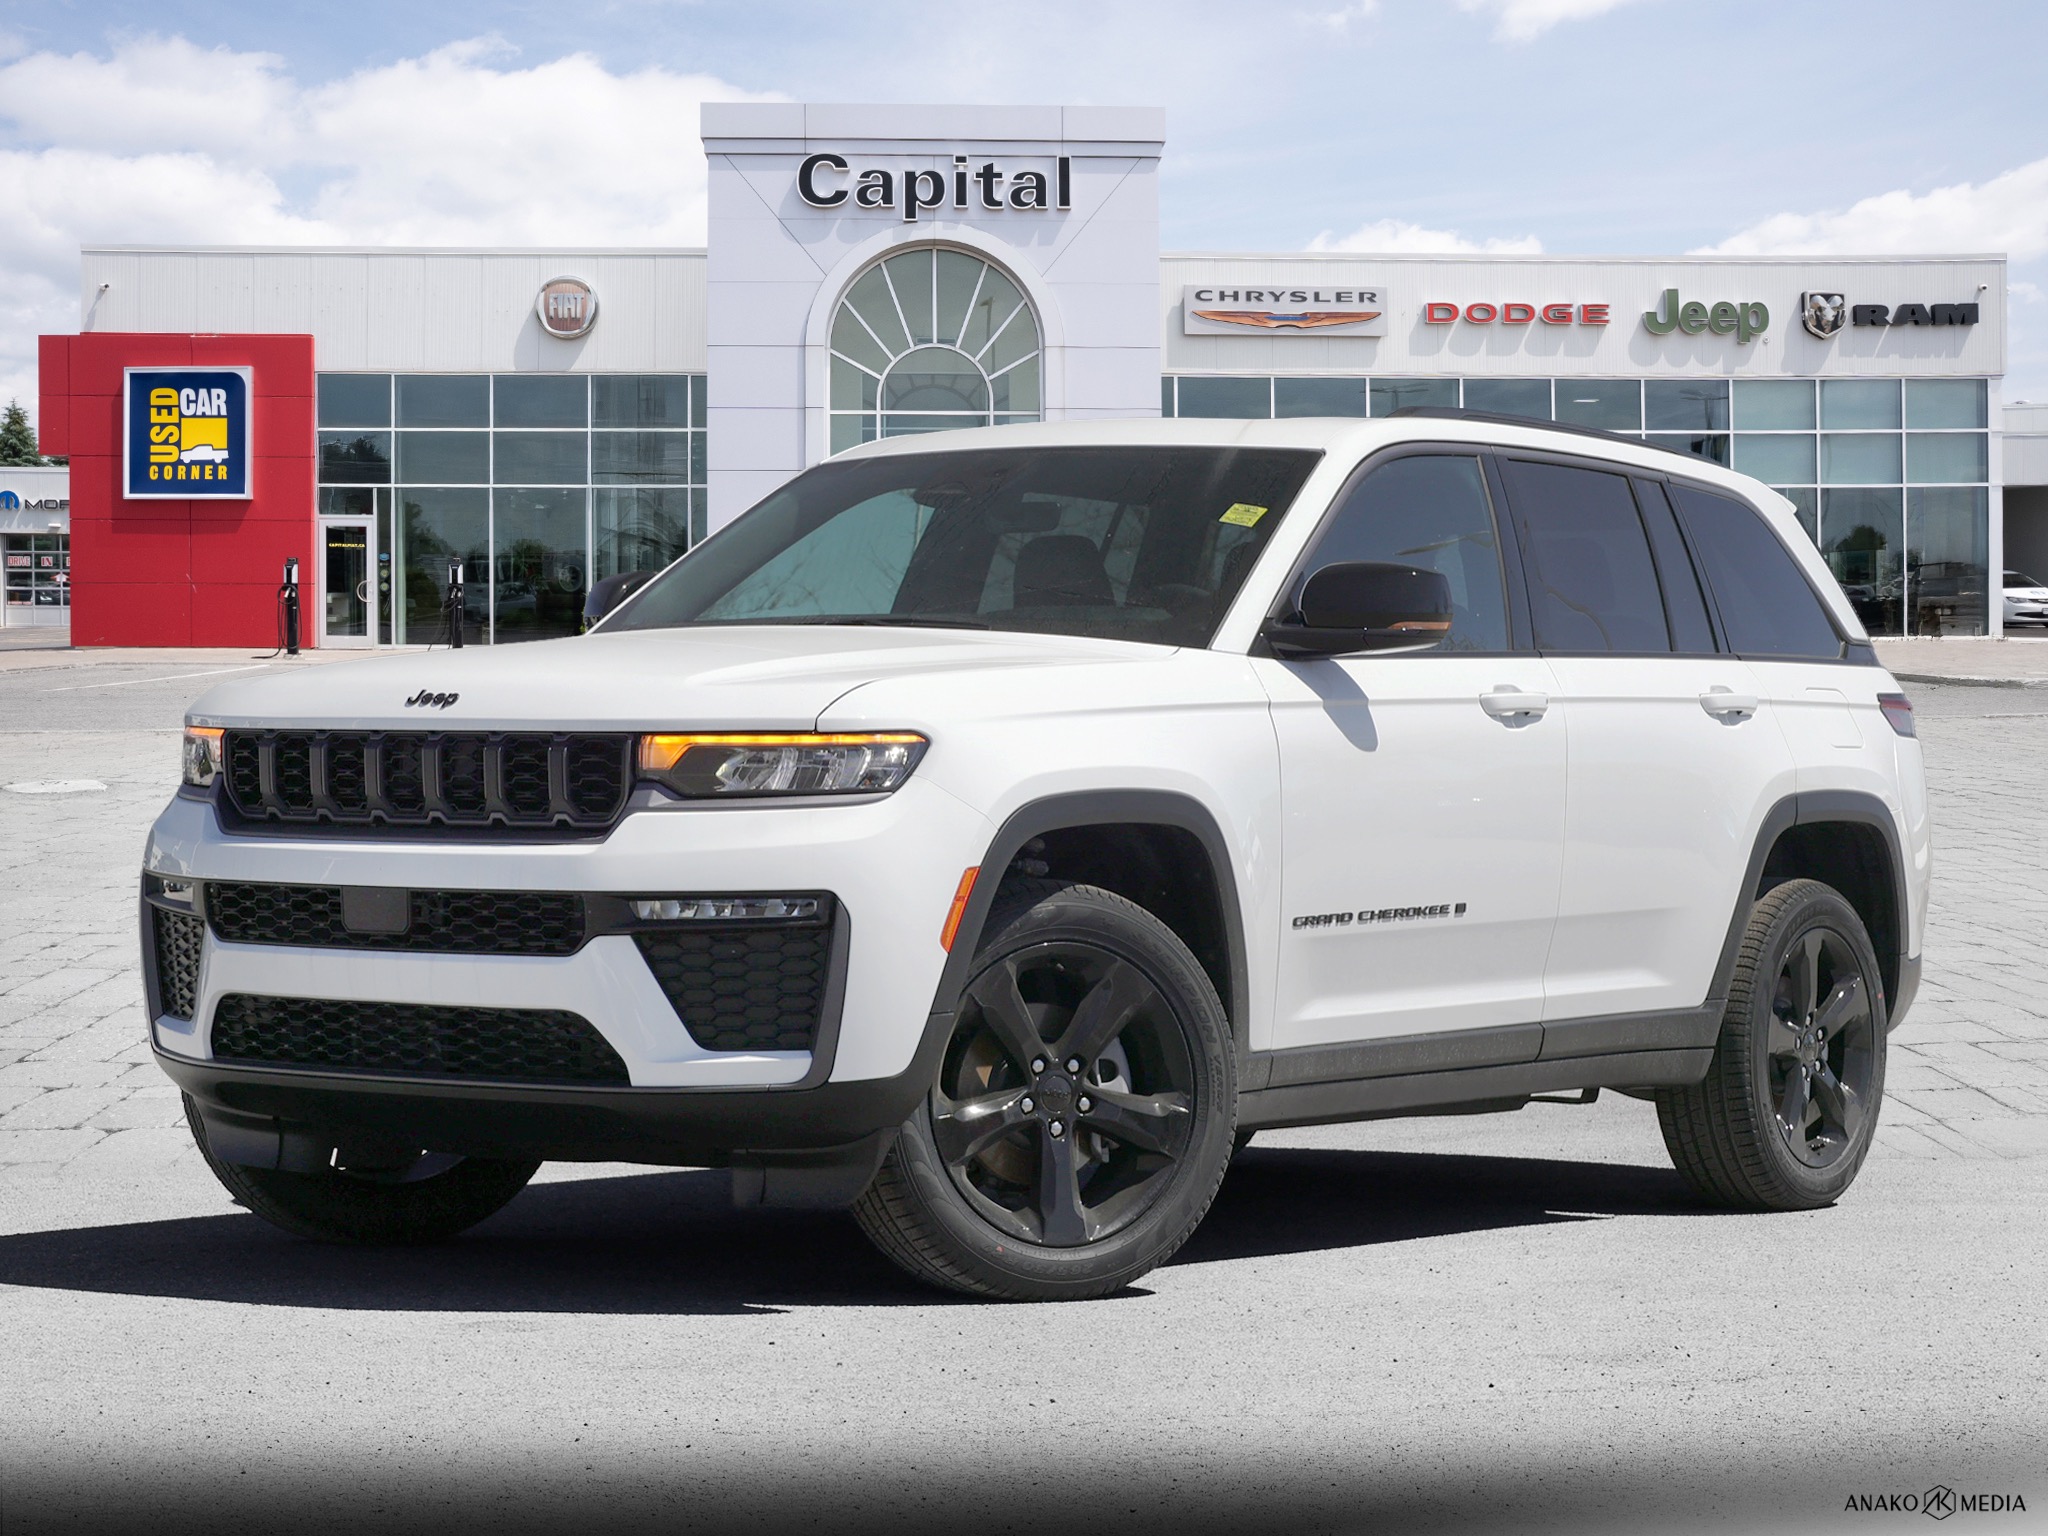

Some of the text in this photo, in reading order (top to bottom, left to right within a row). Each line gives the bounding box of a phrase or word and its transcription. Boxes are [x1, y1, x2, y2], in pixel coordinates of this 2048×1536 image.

[797, 152, 1071, 222] Capital
[549, 292, 583, 319] FIAT
[1195, 289, 1377, 303] CHRYSLER
[1425, 303, 1610, 325] DODGE
[1643, 288, 1769, 344] Jeep
[1852, 303, 1979, 326] RAM
[180, 387, 228, 416] CAR
[150, 387, 180, 463] USED
[149, 464, 228, 480] CORNER
[25, 499, 70, 510] MOP
[8, 555, 31, 567] DRIVE
[41, 556, 53, 567] IN
[1292, 903, 1451, 929] GRAND CHEROKEE
